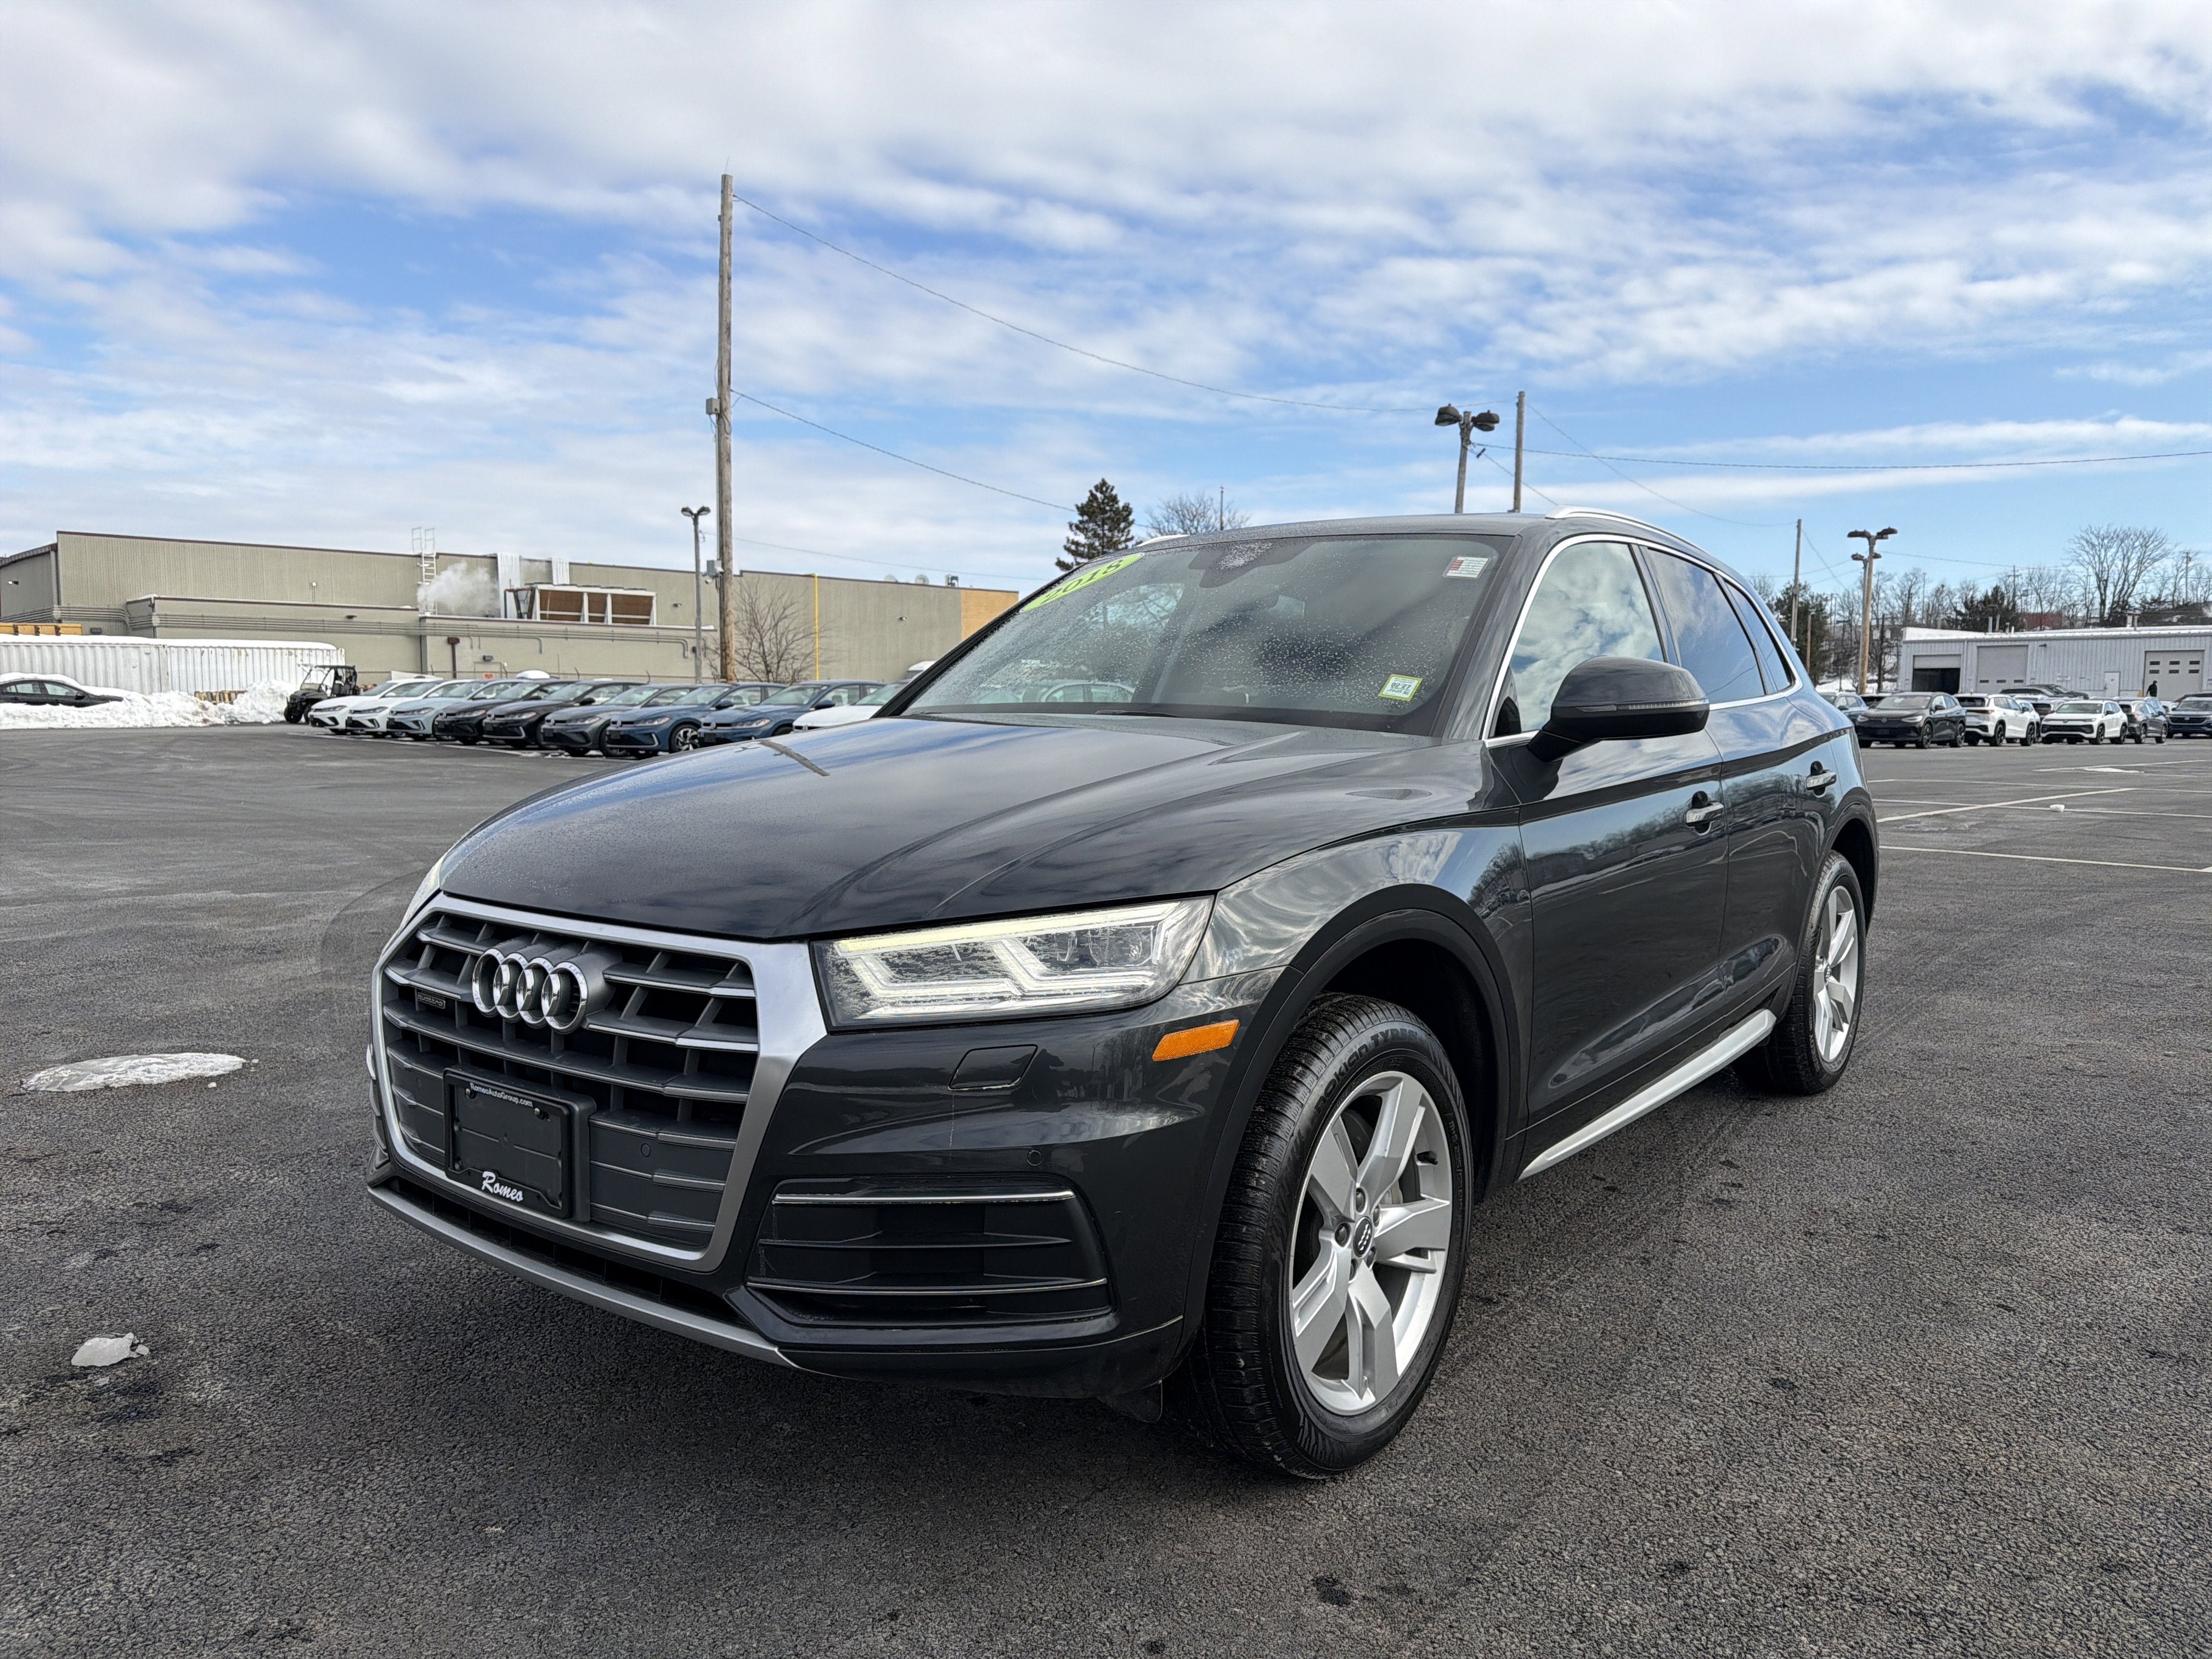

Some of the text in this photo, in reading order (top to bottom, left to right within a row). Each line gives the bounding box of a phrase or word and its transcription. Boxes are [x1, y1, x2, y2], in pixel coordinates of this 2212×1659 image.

[1041, 560, 1124, 603] 2018
[417, 994, 443, 1007] quattro
[470, 1082, 533, 1108] RomeoAutoGroup.com
[481, 1171, 523, 1202] Romeo
